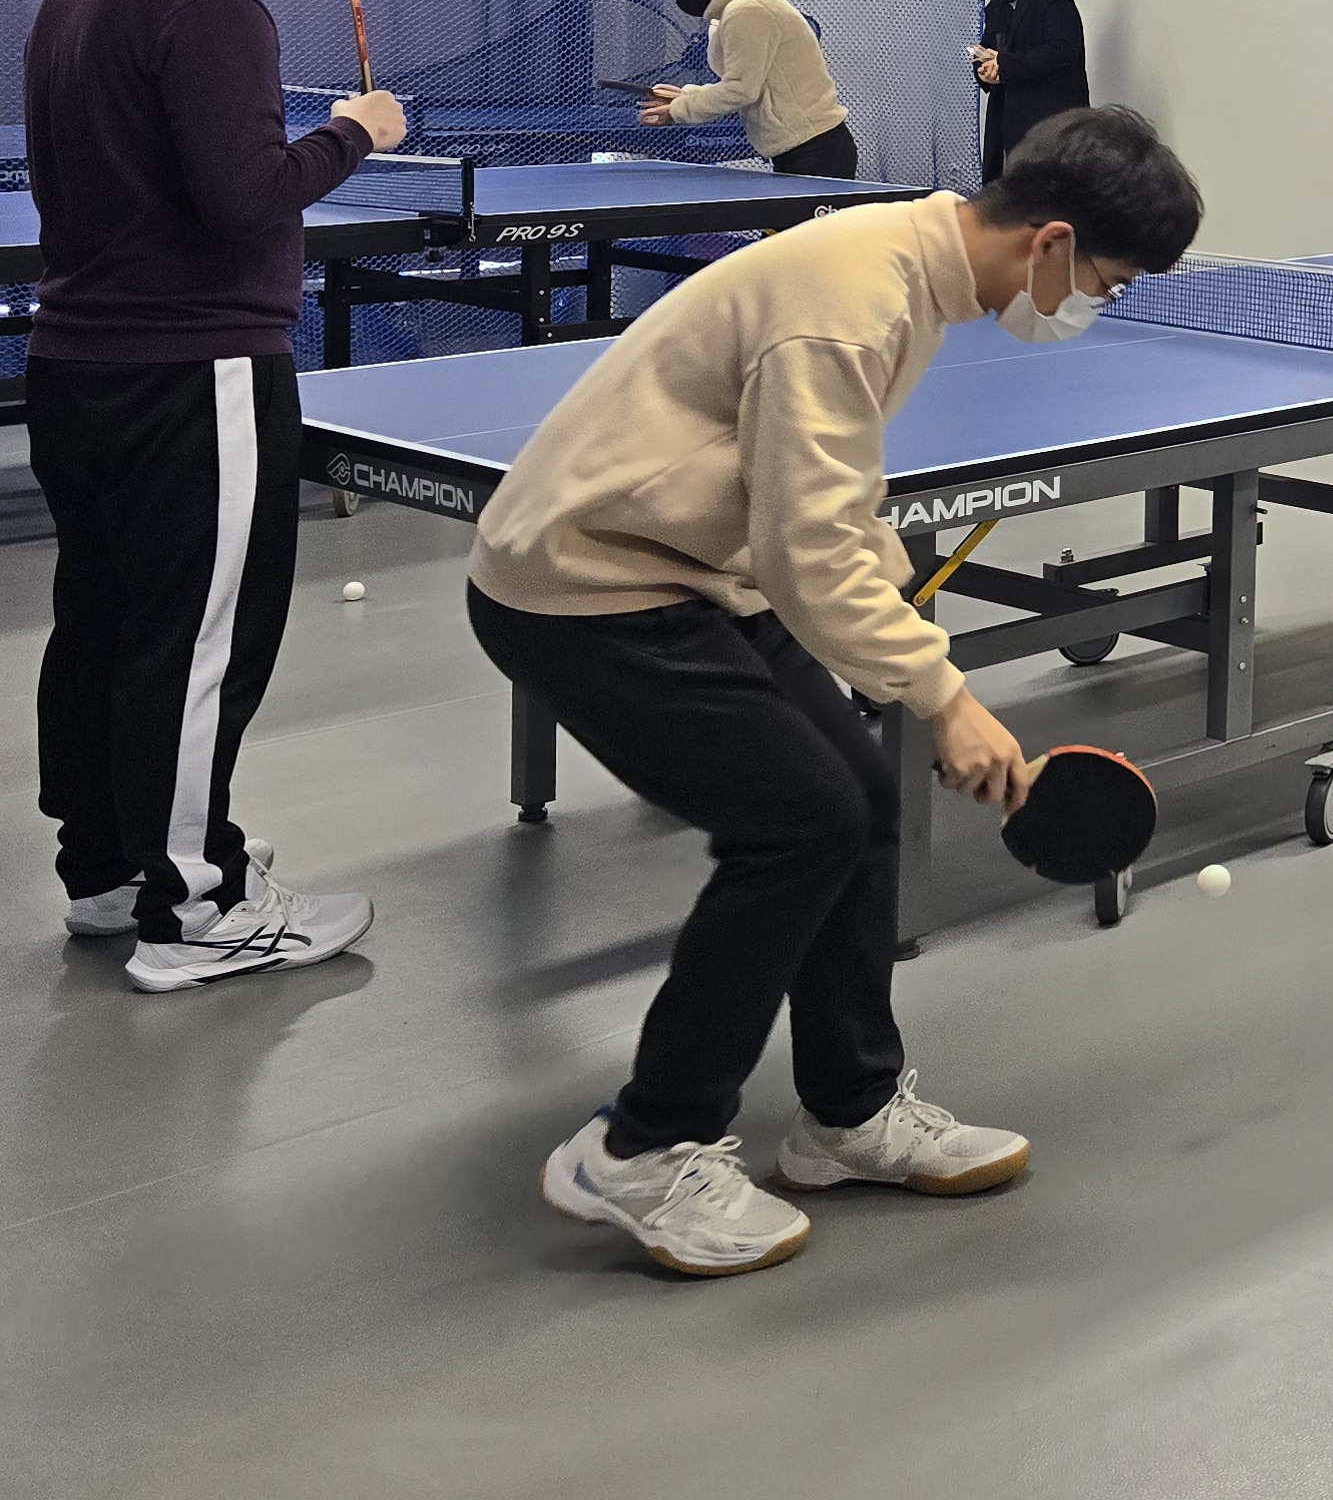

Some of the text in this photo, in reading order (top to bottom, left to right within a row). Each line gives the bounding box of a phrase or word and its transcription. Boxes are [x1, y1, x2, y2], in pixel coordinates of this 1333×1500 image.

[496, 223, 584, 242] PRO 9S
[353, 463, 474, 513] CHAMPION
[878, 475, 1061, 531] HAMPION
